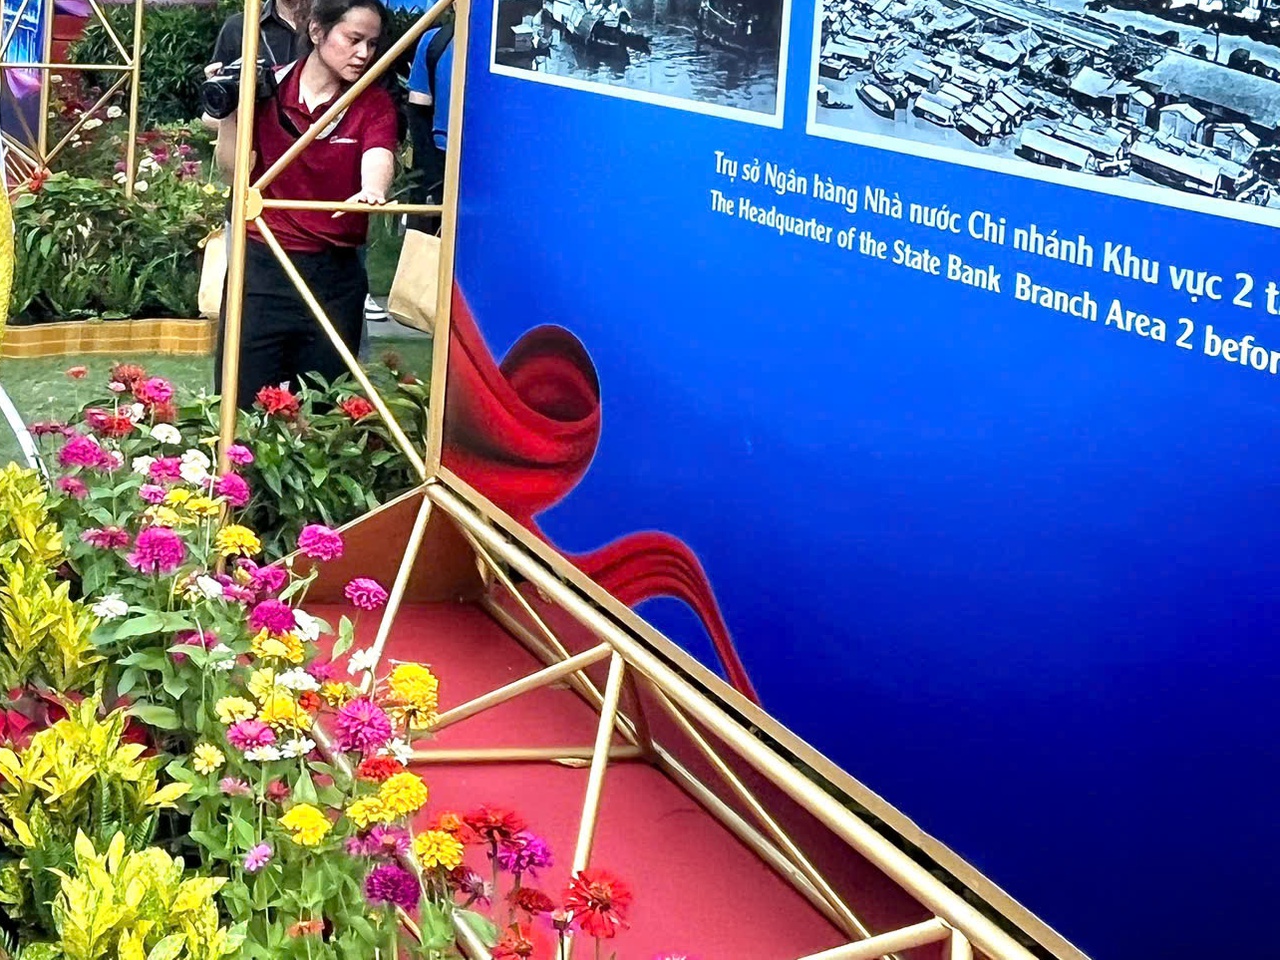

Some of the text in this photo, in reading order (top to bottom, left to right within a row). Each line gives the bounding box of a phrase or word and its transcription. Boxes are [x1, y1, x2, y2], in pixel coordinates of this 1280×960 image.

[710, 189, 734, 215] The
[738, 198, 833, 244] Headquarter
[837, 226, 856, 250] of
[859, 231, 888, 259] the
[892, 240, 940, 275] State
[947, 253, 1001, 293] Bank
[1014, 272, 1098, 322] Branch
[1105, 299, 1166, 342] Area
[1176, 318, 1195, 350] 2
[714, 150, 738, 183] Trụ
[741, 158, 759, 183] sở
[764, 161, 807, 196] Ngân
[813, 173, 858, 213] hàng
[864, 185, 902, 219] Nhà
[909, 203, 961, 234] nước
[968, 210, 1007, 245] Chi
[1014, 224, 1093, 267] nhánh
[1103, 241, 1160, 284] Khu
[1169, 265, 1222, 302] vực
[1233, 273, 1254, 308] 2
